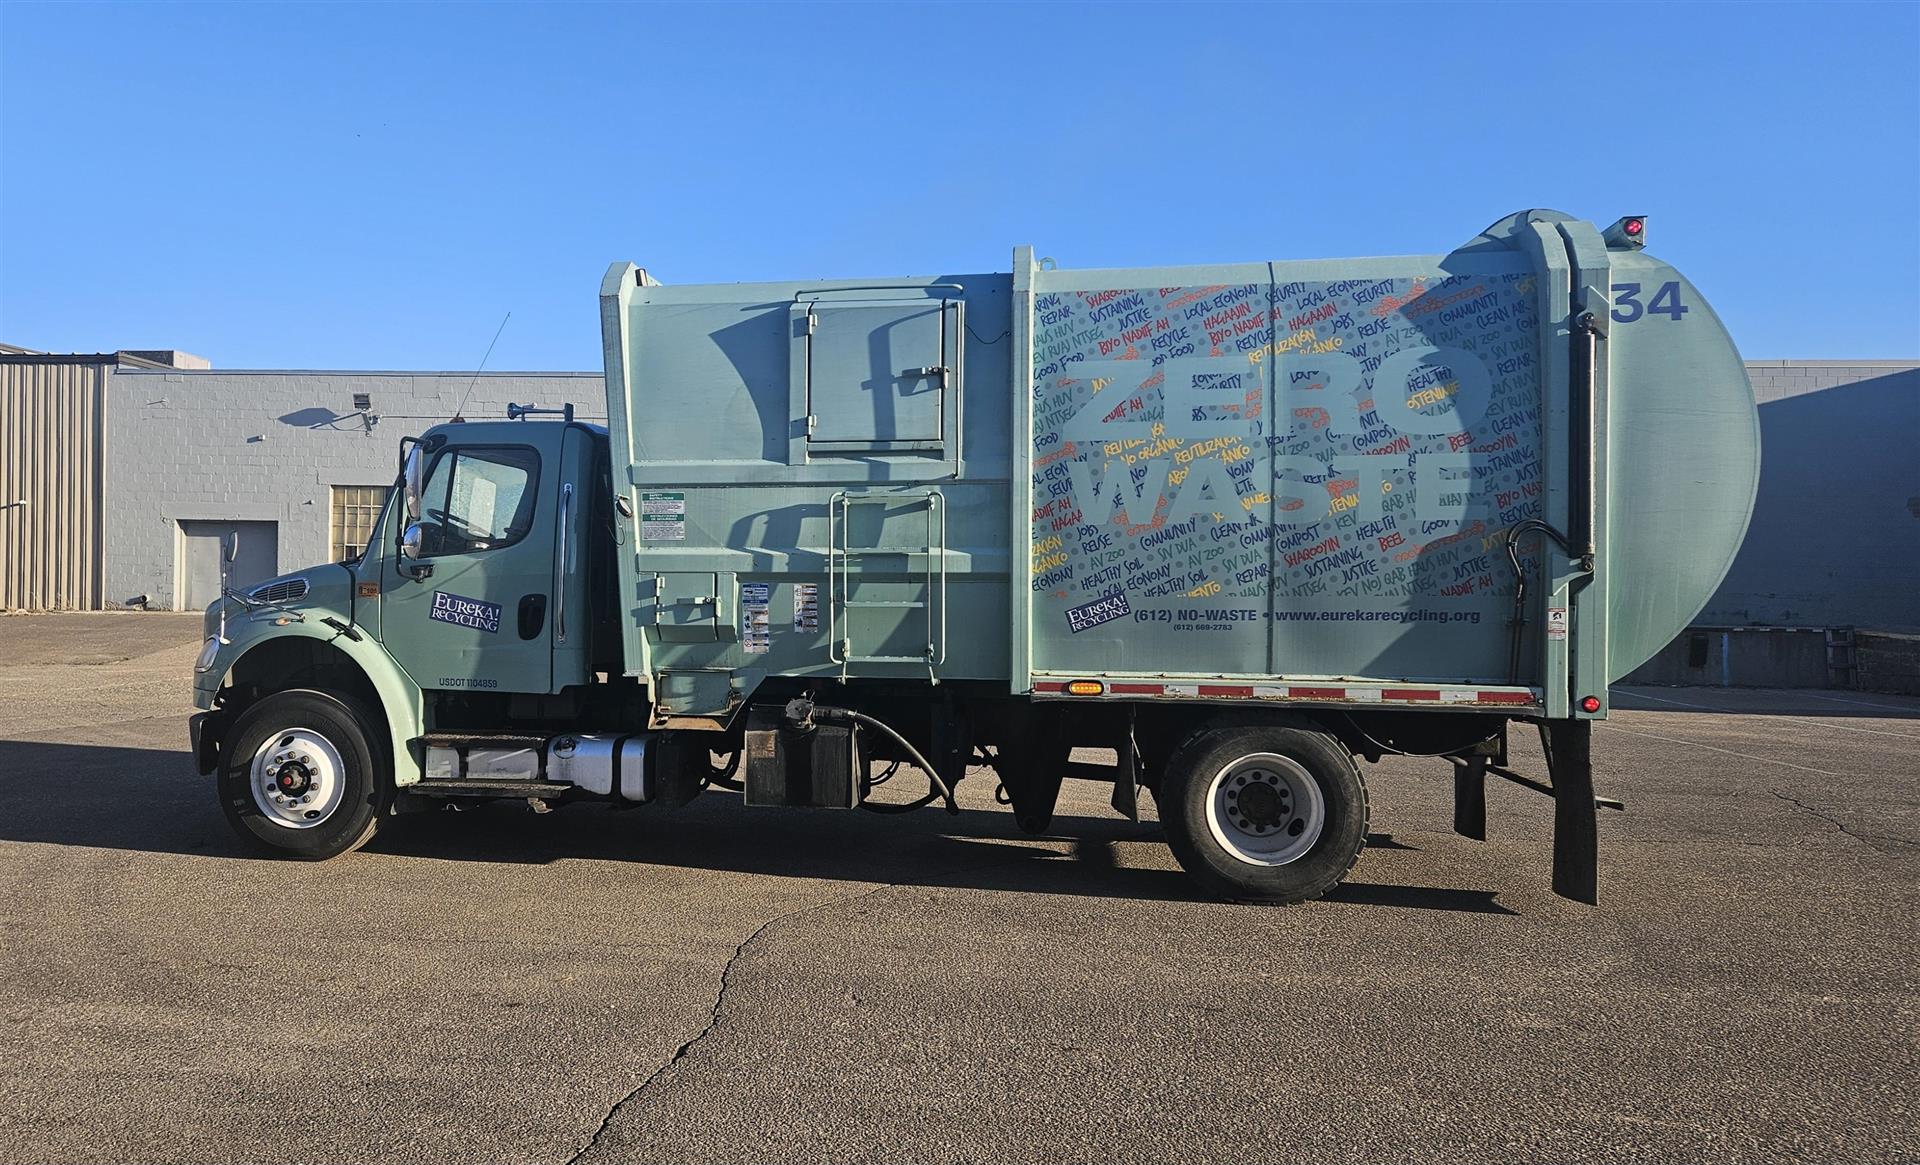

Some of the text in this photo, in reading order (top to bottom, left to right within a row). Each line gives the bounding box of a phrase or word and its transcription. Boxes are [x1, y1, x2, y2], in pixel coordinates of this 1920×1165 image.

[1184, 302, 1213, 320] LOCAL
[1213, 283, 1258, 308] ECONOMY
[1296, 290, 1327, 310] LOCAL
[1352, 279, 1394, 306] SECURITY
[1609, 281, 1689, 323] 34
[1040, 305, 1076, 327] REPAIR
[1089, 292, 1145, 325] SUSTAINING
[1118, 307, 1153, 332] JUSTICE
[1439, 291, 1498, 327] COMMUNITY
[1476, 305, 1510, 330] CLEAN
[1512, 299, 1532, 317] AIR
[1331, 312, 1355, 334] JOBS
[1357, 317, 1391, 339] REUSE
[1098, 338, 1121, 356] BIYO
[1156, 316, 1170, 333] AH
[1151, 326, 1190, 351] RECYCLE
[1208, 328, 1232, 347] BIYO
[1236, 327, 1275, 352] RECYCLE
[1168, 342, 1195, 359] FOOD
[1033, 362, 1059, 381] GOOD
[1497, 352, 1537, 376] REPAIR
[1061, 346, 1493, 441] ZERO
[1129, 396, 1144, 413] AH
[1492, 411, 1526, 435] CLEAN
[1033, 432, 1059, 452] FOOD
[1448, 431, 1476, 452] BEEL
[1066, 454, 1490, 526] WASTE
[1032, 496, 1072, 523] ADIIF AH
[1335, 510, 1358, 530] KEV
[1499, 499, 1543, 525] RECYCLE
[1076, 525, 1099, 541] JOBS
[1082, 533, 1113, 555] REUSE
[1211, 522, 1242, 543] CLEAN
[1276, 523, 1320, 553] COMPOST
[1377, 532, 1406, 552] BEEL
[1090, 552, 1104, 570] AV
[1187, 551, 1202, 569] AV
[1304, 545, 1364, 579] SUSTAINING
[1032, 564, 1073, 592] ECONOMY
[1081, 557, 1145, 590] HEALTHY SOIL
[1126, 563, 1170, 590] ECONOMY
[1187, 568, 1209, 587] SOIL
[1236, 563, 1272, 586] REPAIR
[1341, 559, 1379, 585] JUSTICE
[1478, 573, 1494, 591] AH
[1134, 609, 1480, 624] (612) NO-WASTE www.eurekarecycling.org
[439, 678, 465, 687] USDOT
